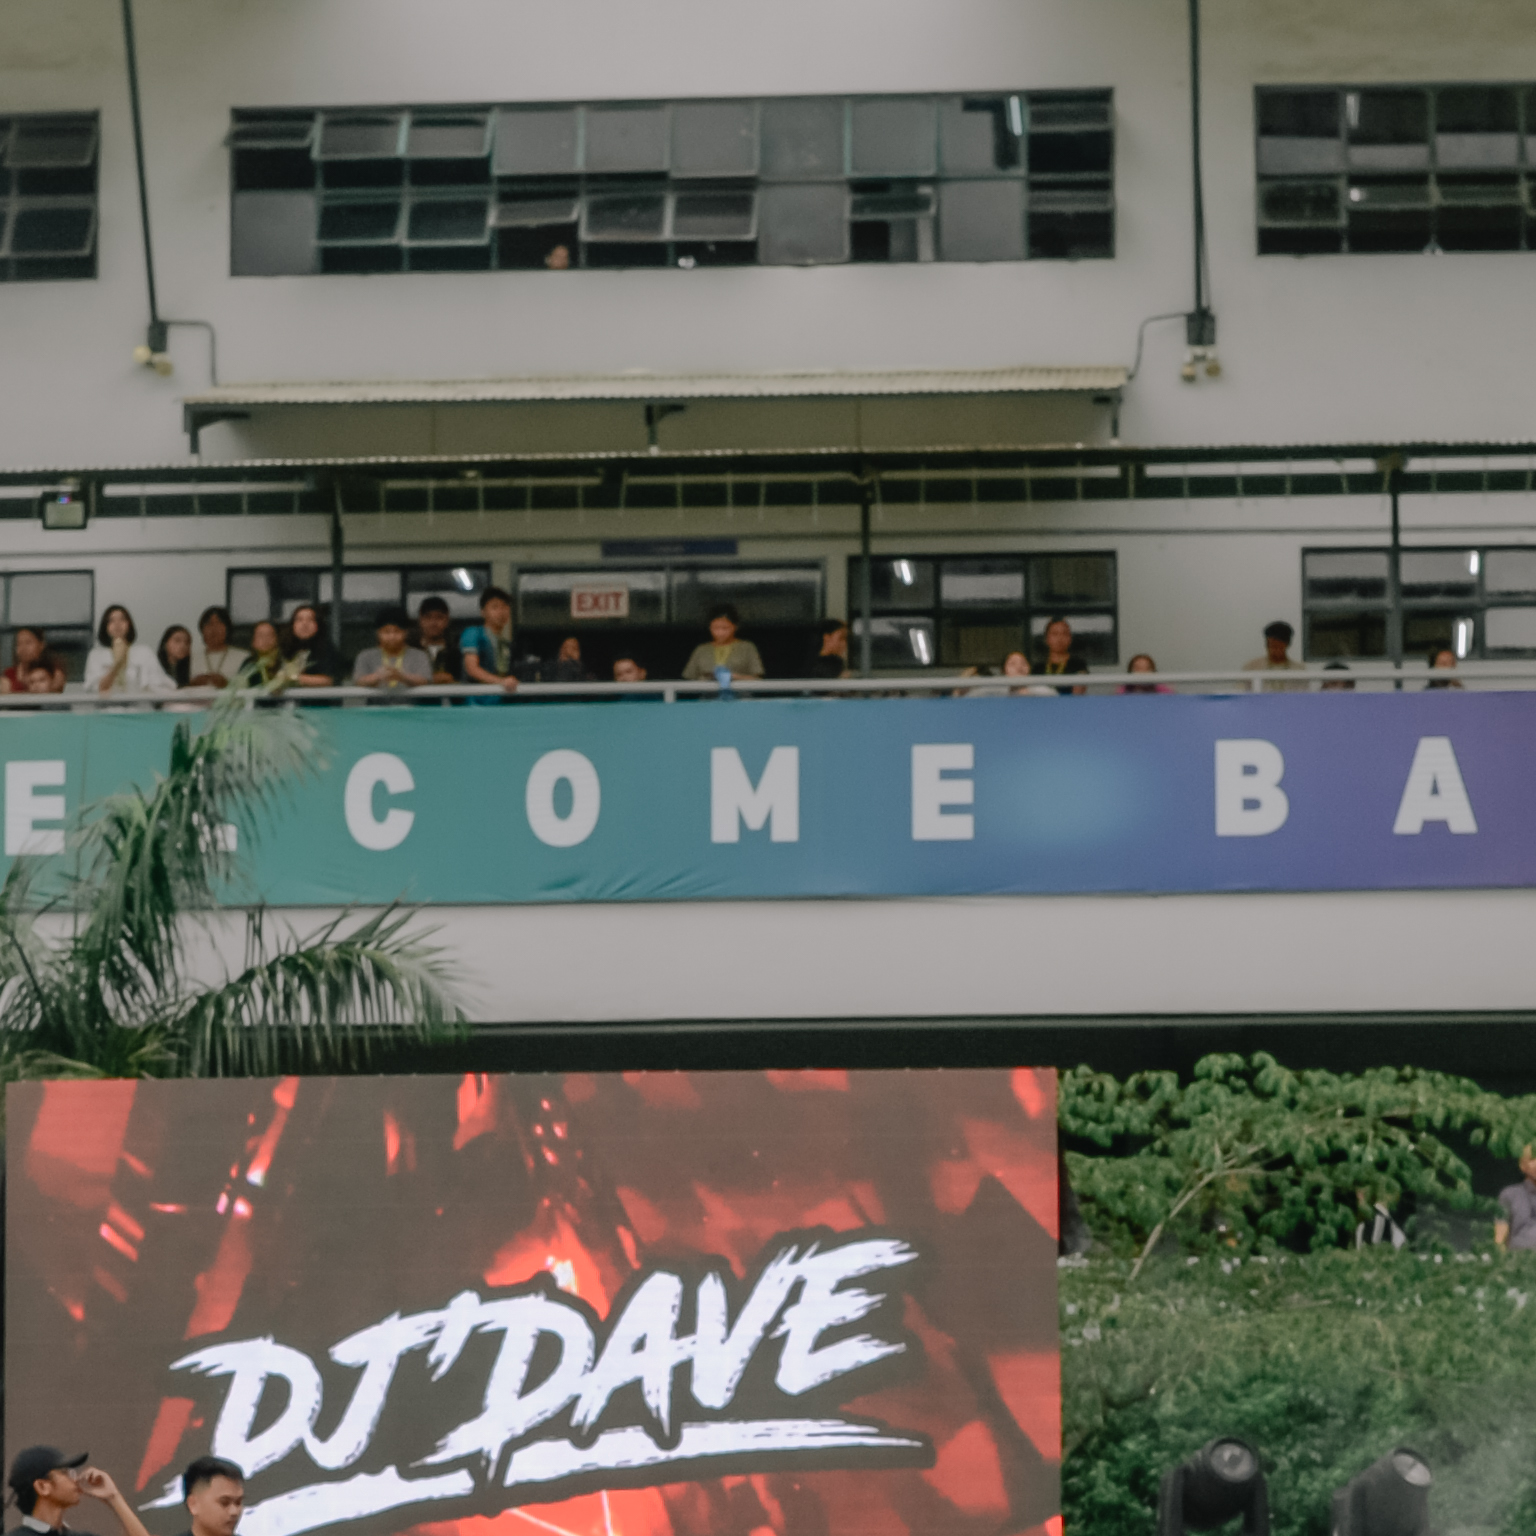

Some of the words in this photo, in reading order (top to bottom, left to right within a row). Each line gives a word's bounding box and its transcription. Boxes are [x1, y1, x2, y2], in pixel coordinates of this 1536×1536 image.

[576, 591, 624, 612] EXIT
[169, 1311, 446, 1480] DJ
[409, 1238, 919, 1482] DAVE
